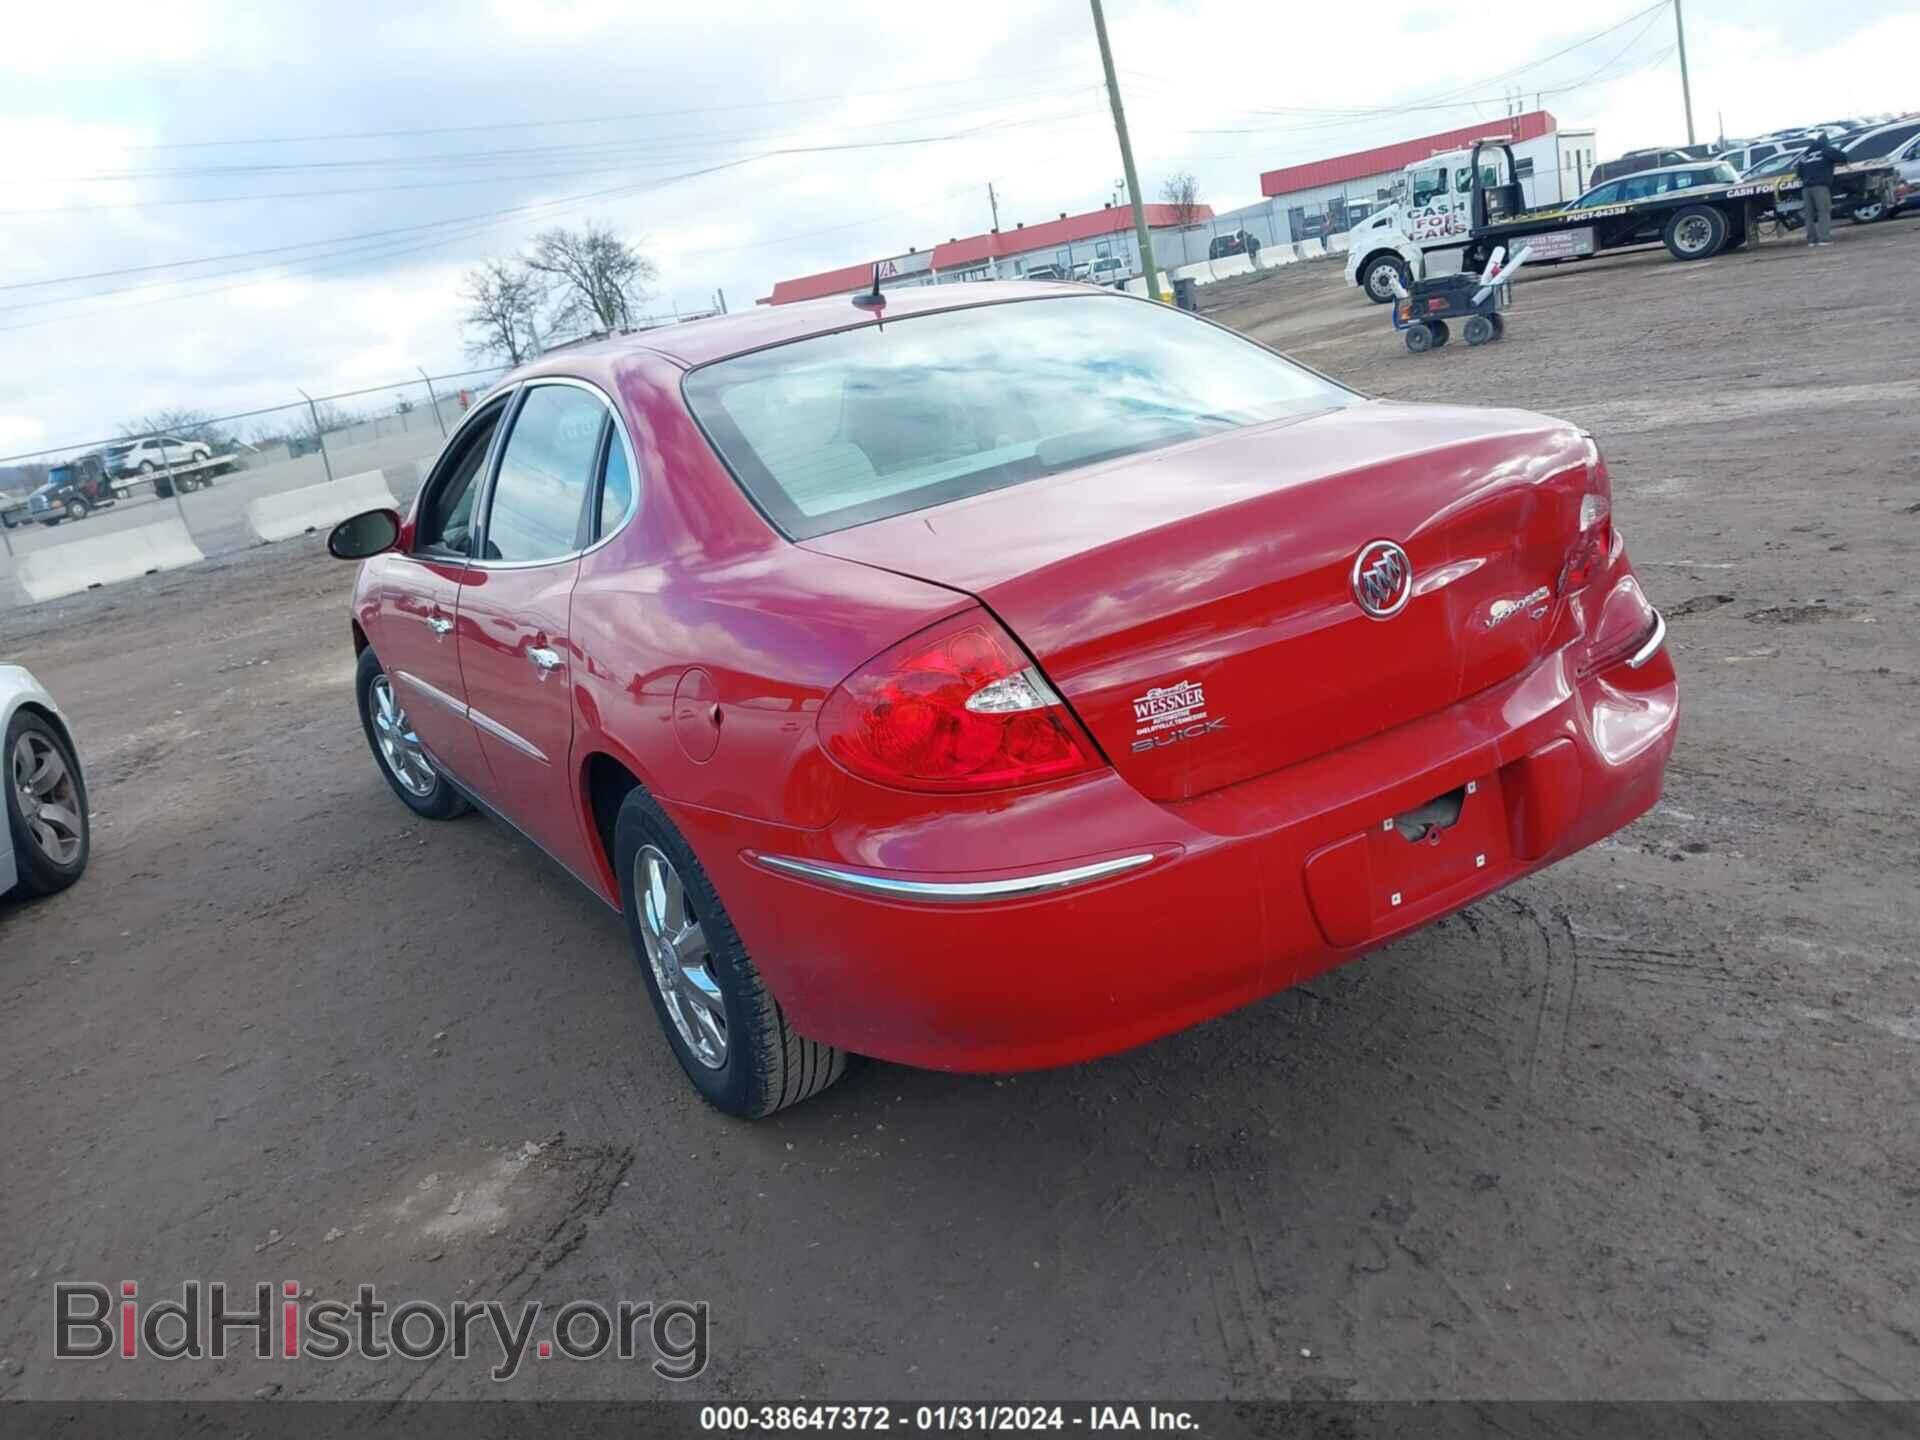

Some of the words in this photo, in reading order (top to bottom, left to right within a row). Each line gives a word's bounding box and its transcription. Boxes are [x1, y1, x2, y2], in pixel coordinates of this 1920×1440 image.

[1726, 187, 1755, 199] CASH
[1407, 201, 1465, 219] CASH
[1416, 213, 1459, 229] FOR
[1133, 687, 1205, 718] WESSNER
[1131, 716, 1230, 753] BUICK
